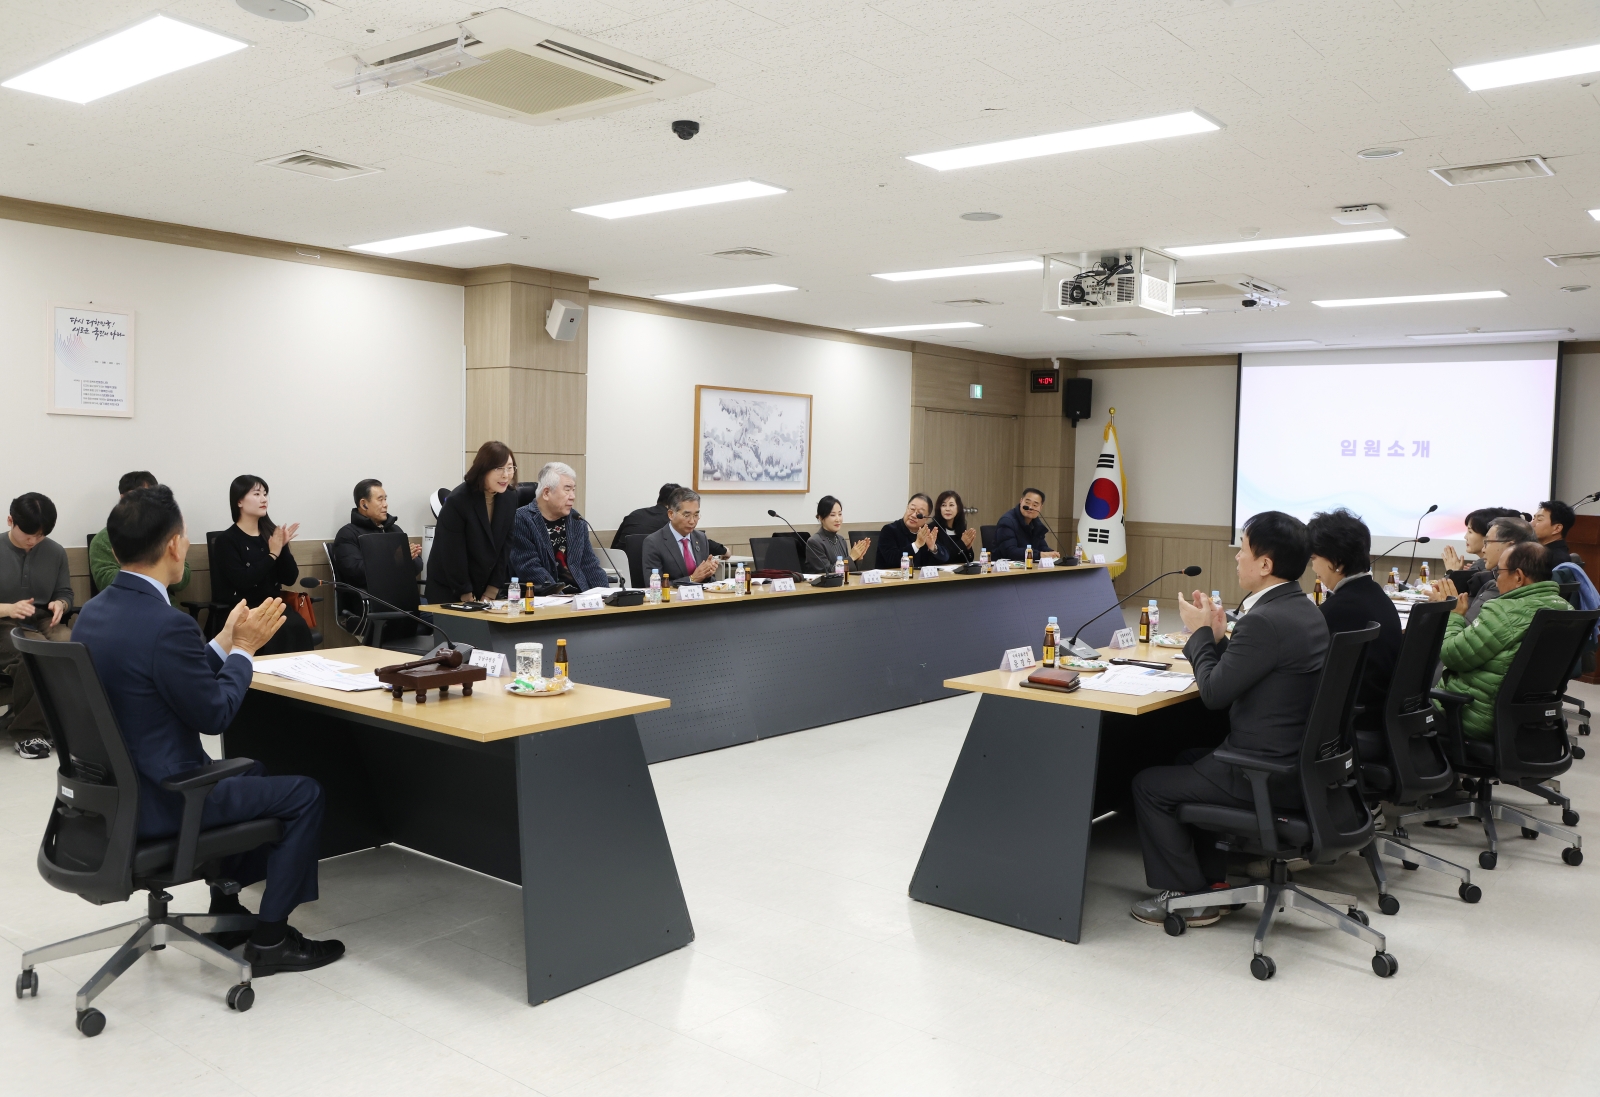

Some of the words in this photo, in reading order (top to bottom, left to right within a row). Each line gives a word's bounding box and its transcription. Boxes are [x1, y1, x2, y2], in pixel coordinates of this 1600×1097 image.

[70, 317, 84, 325] 다시
[86, 318, 116, 329] 대한민국!
[72, 327, 90, 336] 새로운
[1038, 377, 1053, 385] 4:04
[1340, 439, 1430, 458] 임원소개
